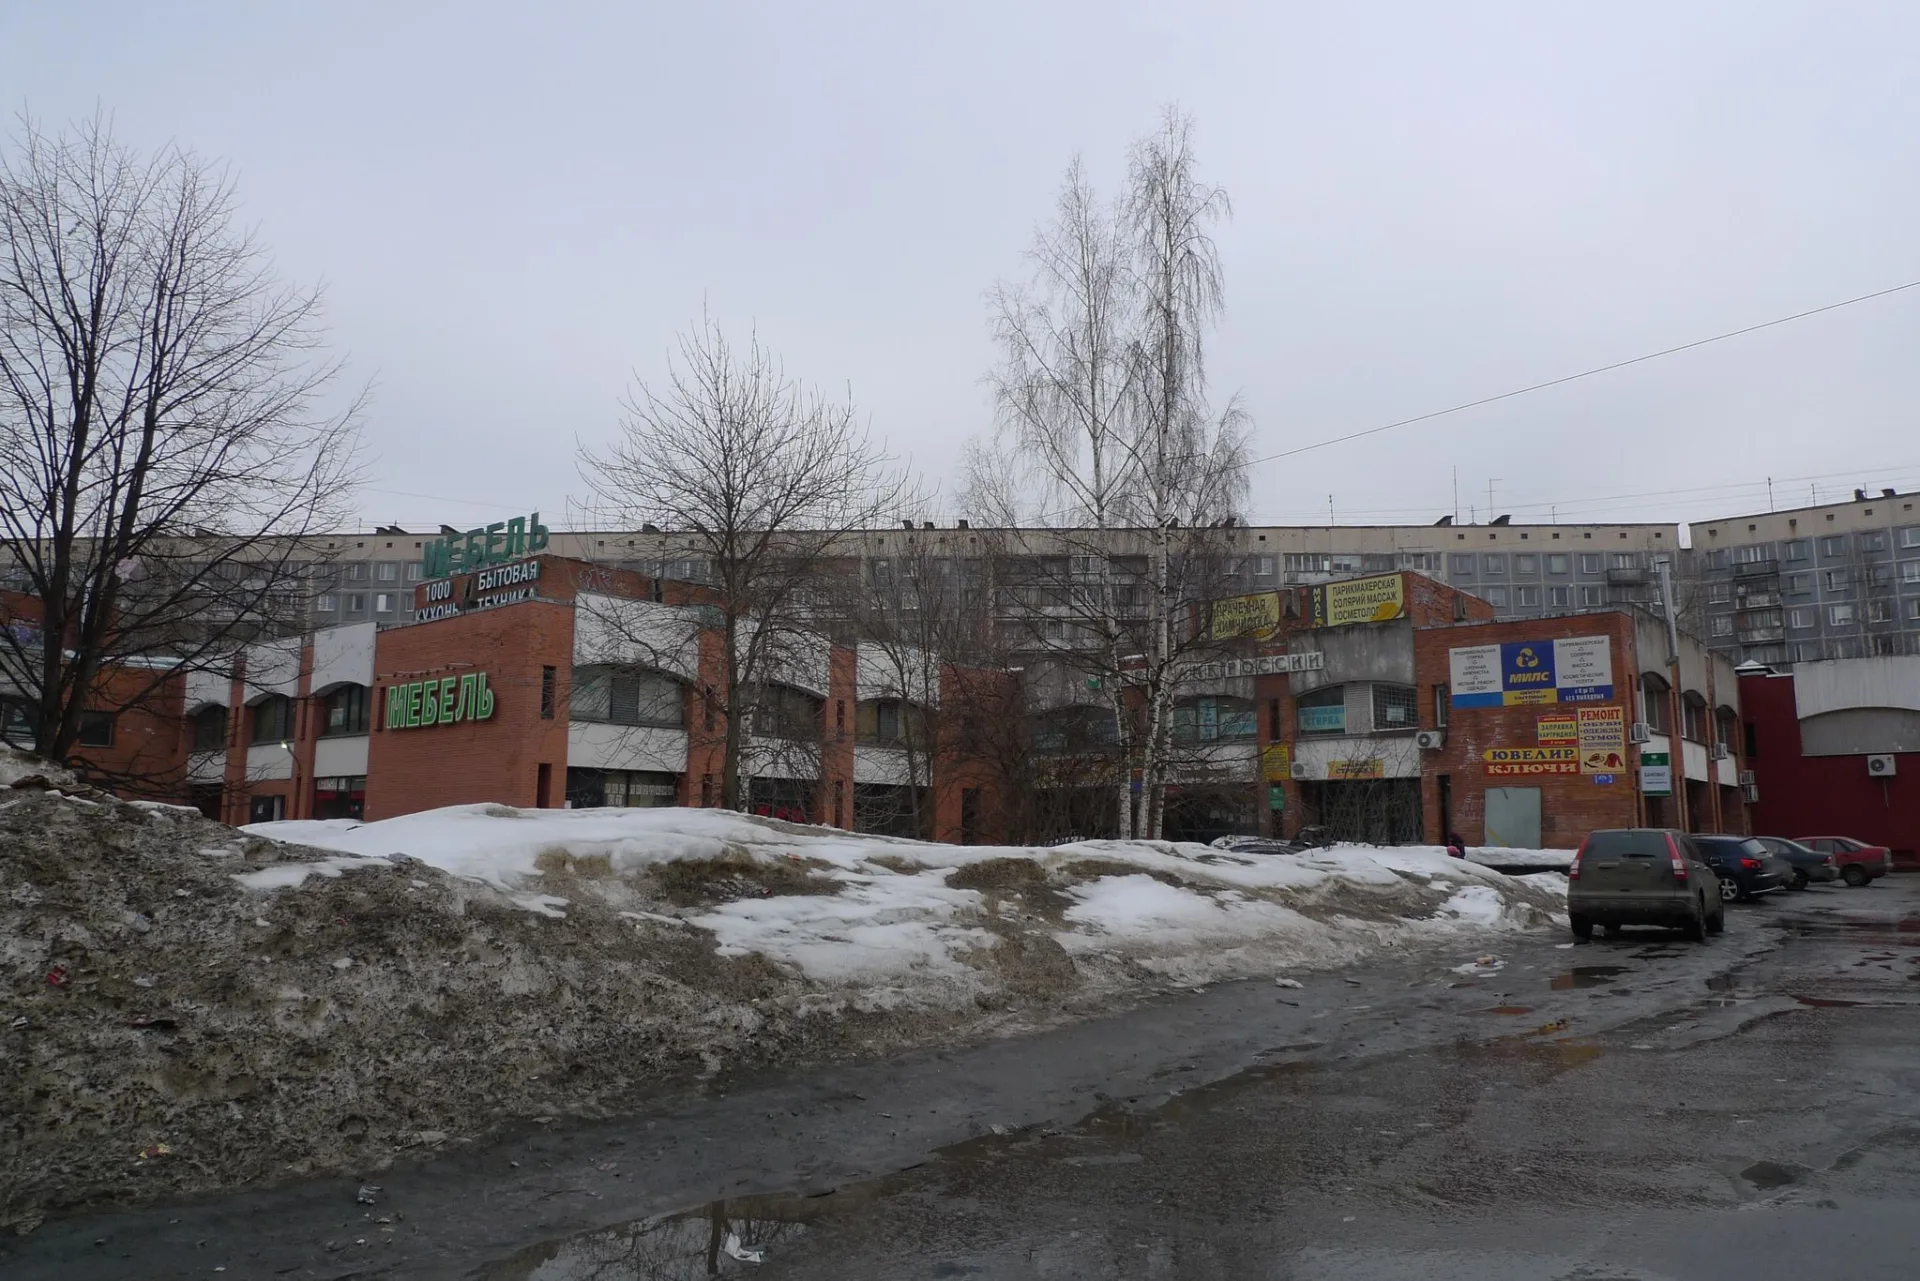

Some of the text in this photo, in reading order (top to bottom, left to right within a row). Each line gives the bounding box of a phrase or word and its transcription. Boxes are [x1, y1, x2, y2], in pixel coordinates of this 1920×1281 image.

[423, 512, 549, 577] МЕБЕЛЬ
[478, 561, 538, 591] БЫТОВАЯ
[426, 581, 451, 602] 1000
[1332, 578, 1396, 596] ПАРИКМАХЕРСКАЯ
[1312, 588, 1321, 617] МИЛС
[1333, 591, 1398, 609] СОЛЯРИЙ МАССАЖ
[1227, 653, 1322, 677] РОССИИ
[1509, 671, 1550, 684] МИЛС
[386, 671, 494, 730] МЕБЕЛЬ
[1580, 709, 1621, 721] РЕМОНТ
[1541, 723, 1574, 731] ЗАПРАВКА
[1491, 749, 1575, 760] ЮВЕЛИР
[1487, 763, 1577, 774] КЛЮЧИ
